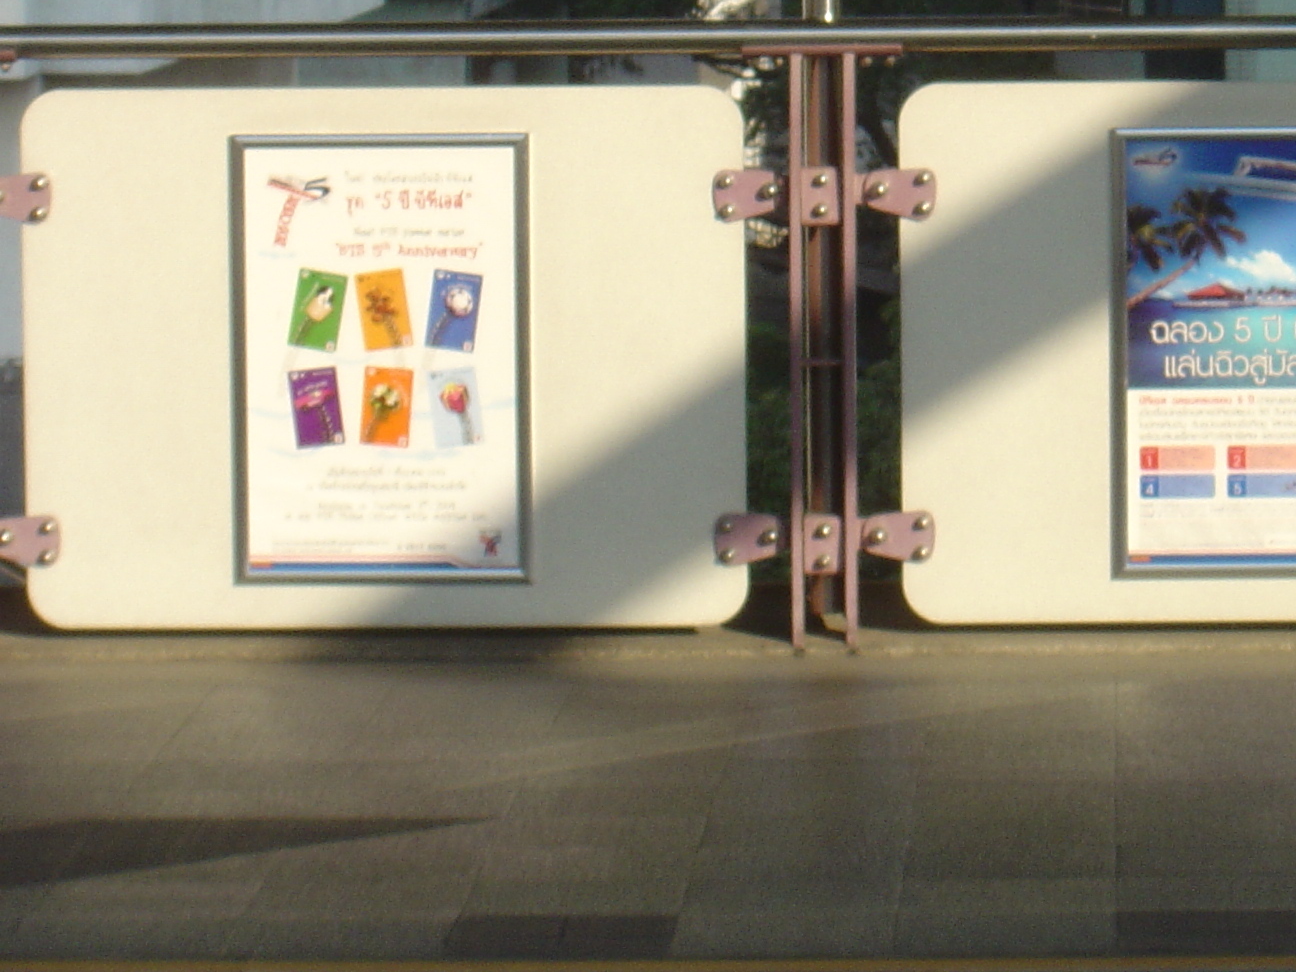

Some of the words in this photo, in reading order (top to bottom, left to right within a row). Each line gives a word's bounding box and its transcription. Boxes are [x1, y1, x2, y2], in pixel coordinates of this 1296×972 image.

[1150, 320, 1225, 344] ฉลอง
[1234, 317, 1251, 343] 5
[1261, 314, 1282, 342] ปี
